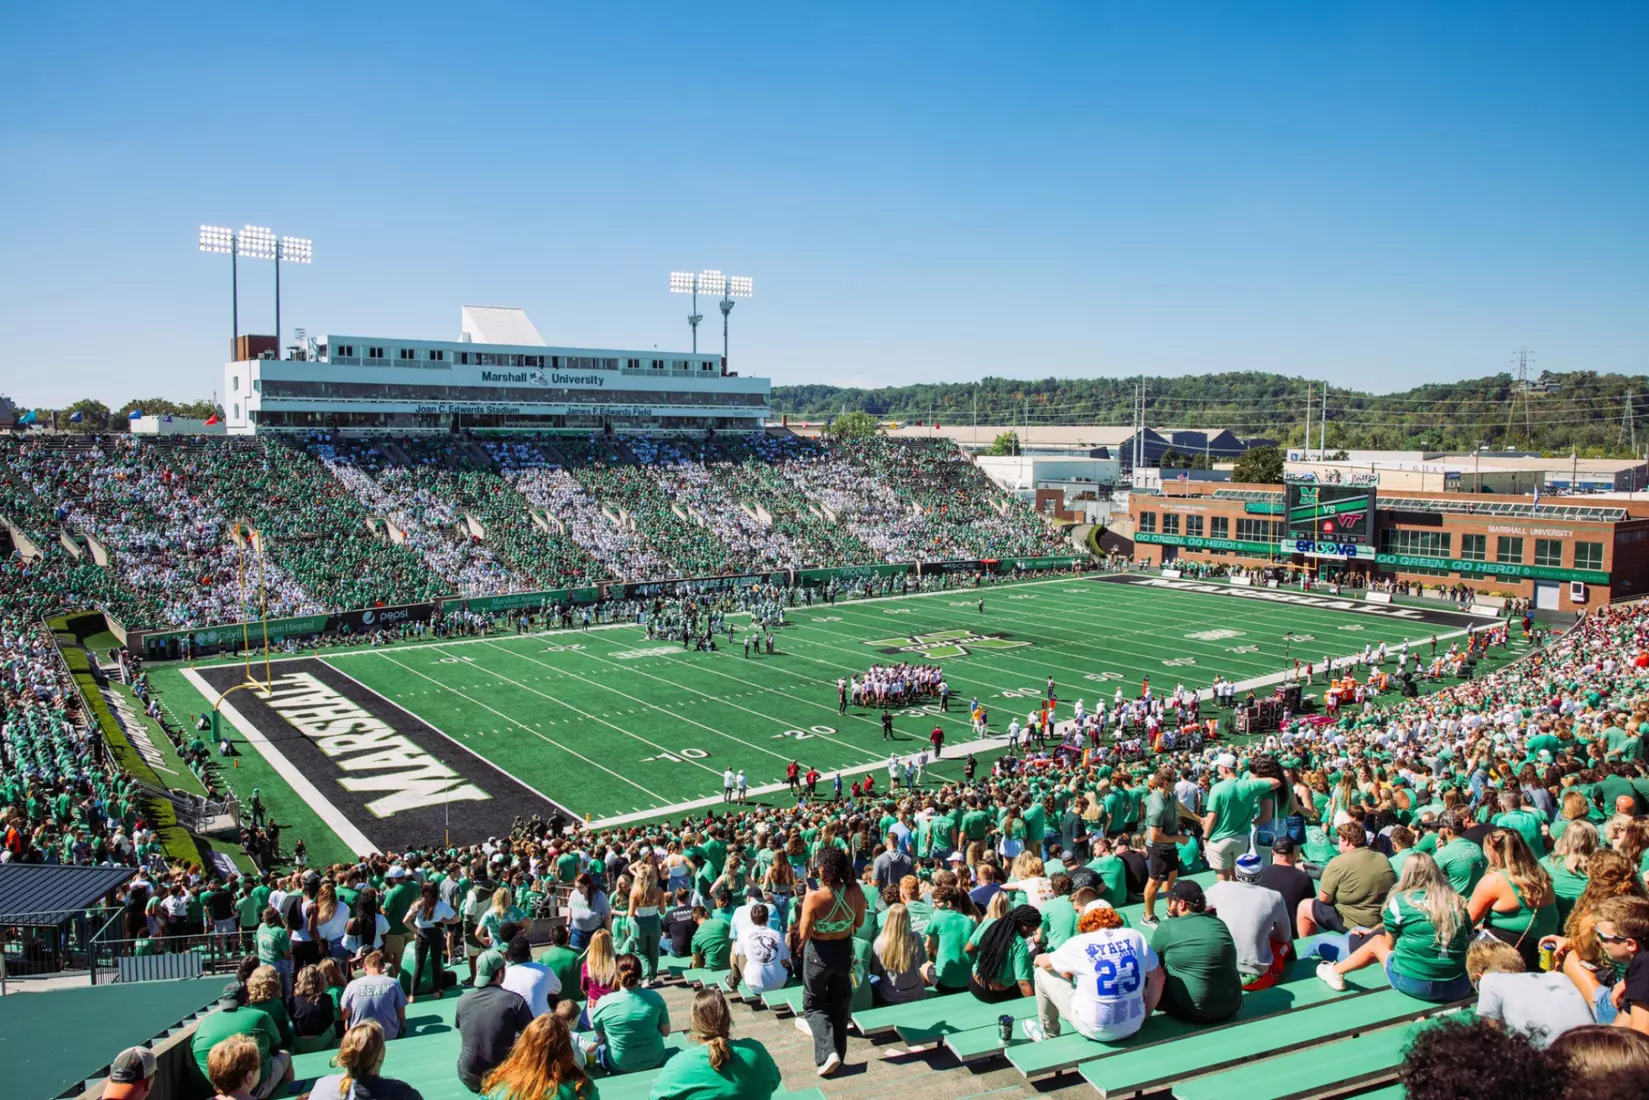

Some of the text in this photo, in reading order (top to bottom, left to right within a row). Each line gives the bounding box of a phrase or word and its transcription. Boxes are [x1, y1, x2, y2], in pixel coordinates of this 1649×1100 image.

[481, 370, 605, 387] Marshall University
[415, 405, 437, 414] Joan
[448, 405, 485, 415] Edwards
[486, 406, 520, 415] Stadium
[566, 407, 592, 417] James
[600, 408, 632, 417] Edwards
[633, 408, 652, 417] Field
[1323, 505, 1336, 514] VS
[1337, 513, 1363, 528] VT
[1488, 525, 1574, 538] MARSHALL UNIVERSITY
[1136, 533, 1150, 542] GO
[1152, 535, 1186, 545] GREEN.
[1188, 538, 1203, 547] GO
[1206, 540, 1236, 550] HERD!
[1296, 540, 1357, 557] encova
[1377, 554, 1521, 575] GO GREEN. GO HERD!
[379, 609, 409, 623] pepsi
[218, 630, 243, 643] Cabell
[284, 620, 314, 633] Hospital
[1002, 687, 1042, 698] 40
[900, 704, 944, 718] 30
[784, 725, 837, 740] 20
[242, 671, 494, 819] MARSHALL
[656, 748, 709, 763] 10
[529, 895, 543, 908] 55
[1095, 955, 1140, 996] 23
[358, 984, 390, 997] TEAM
